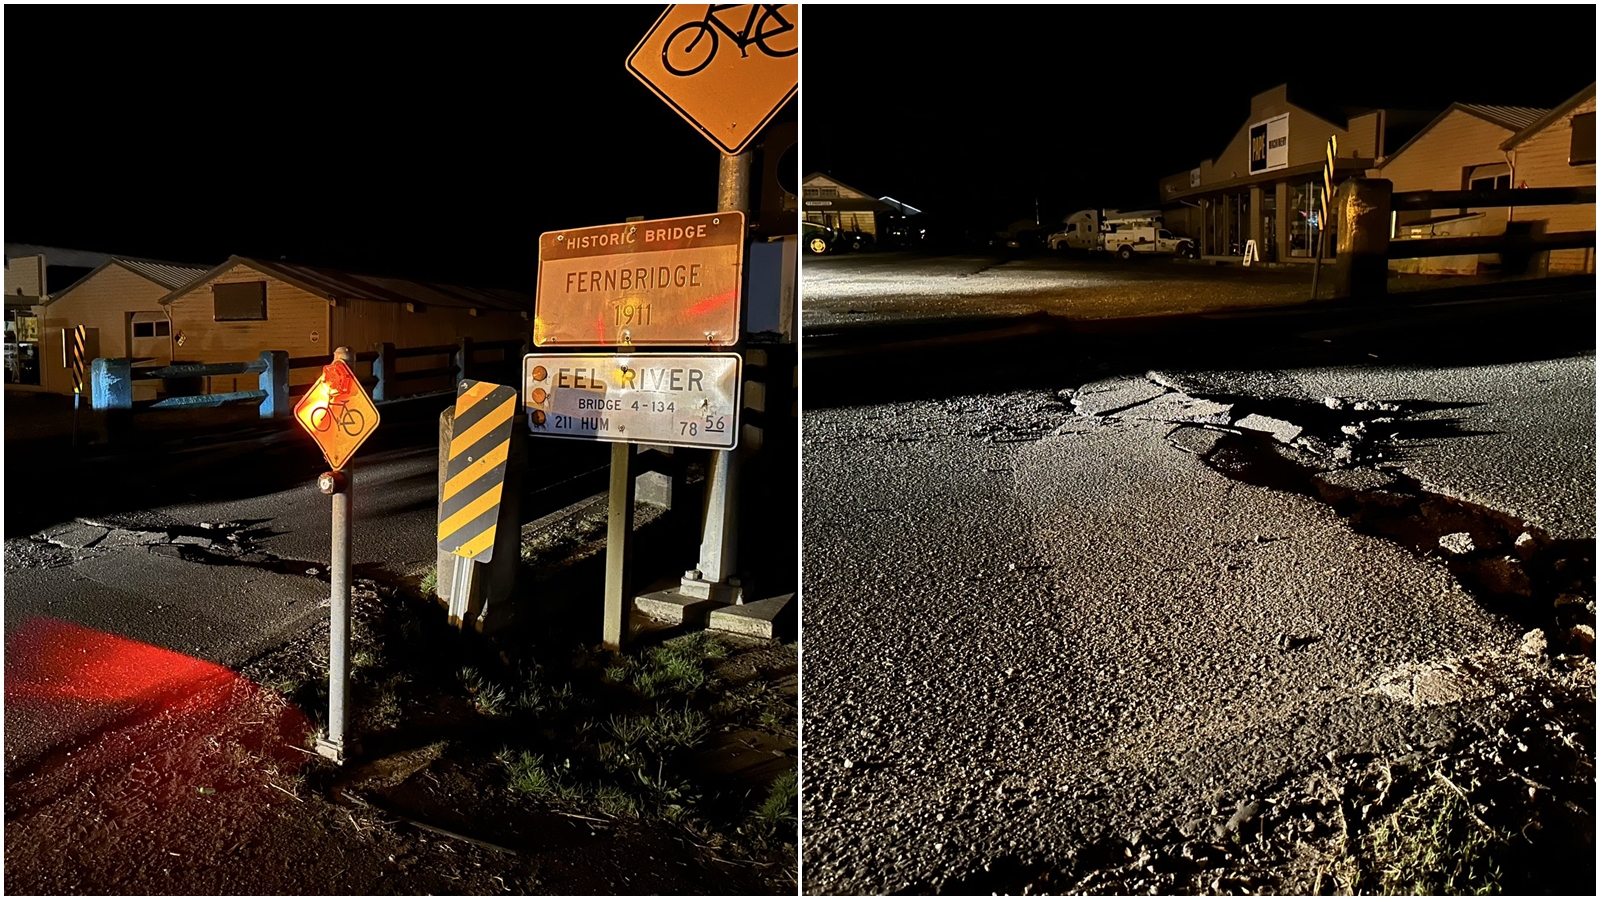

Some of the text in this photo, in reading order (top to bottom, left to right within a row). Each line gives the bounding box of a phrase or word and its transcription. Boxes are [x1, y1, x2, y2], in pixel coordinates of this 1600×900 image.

[566, 224, 707, 250] HISTORIC BRIDGE
[565, 264, 702, 293] FERNBRIDGE
[614, 304, 653, 326] 1911
[557, 368, 704, 392] EEL RIVER
[578, 399, 675, 413] BRIDGE 4-134
[554, 416, 610, 432] 211 HUM
[679, 415, 725, 437] 78 56
